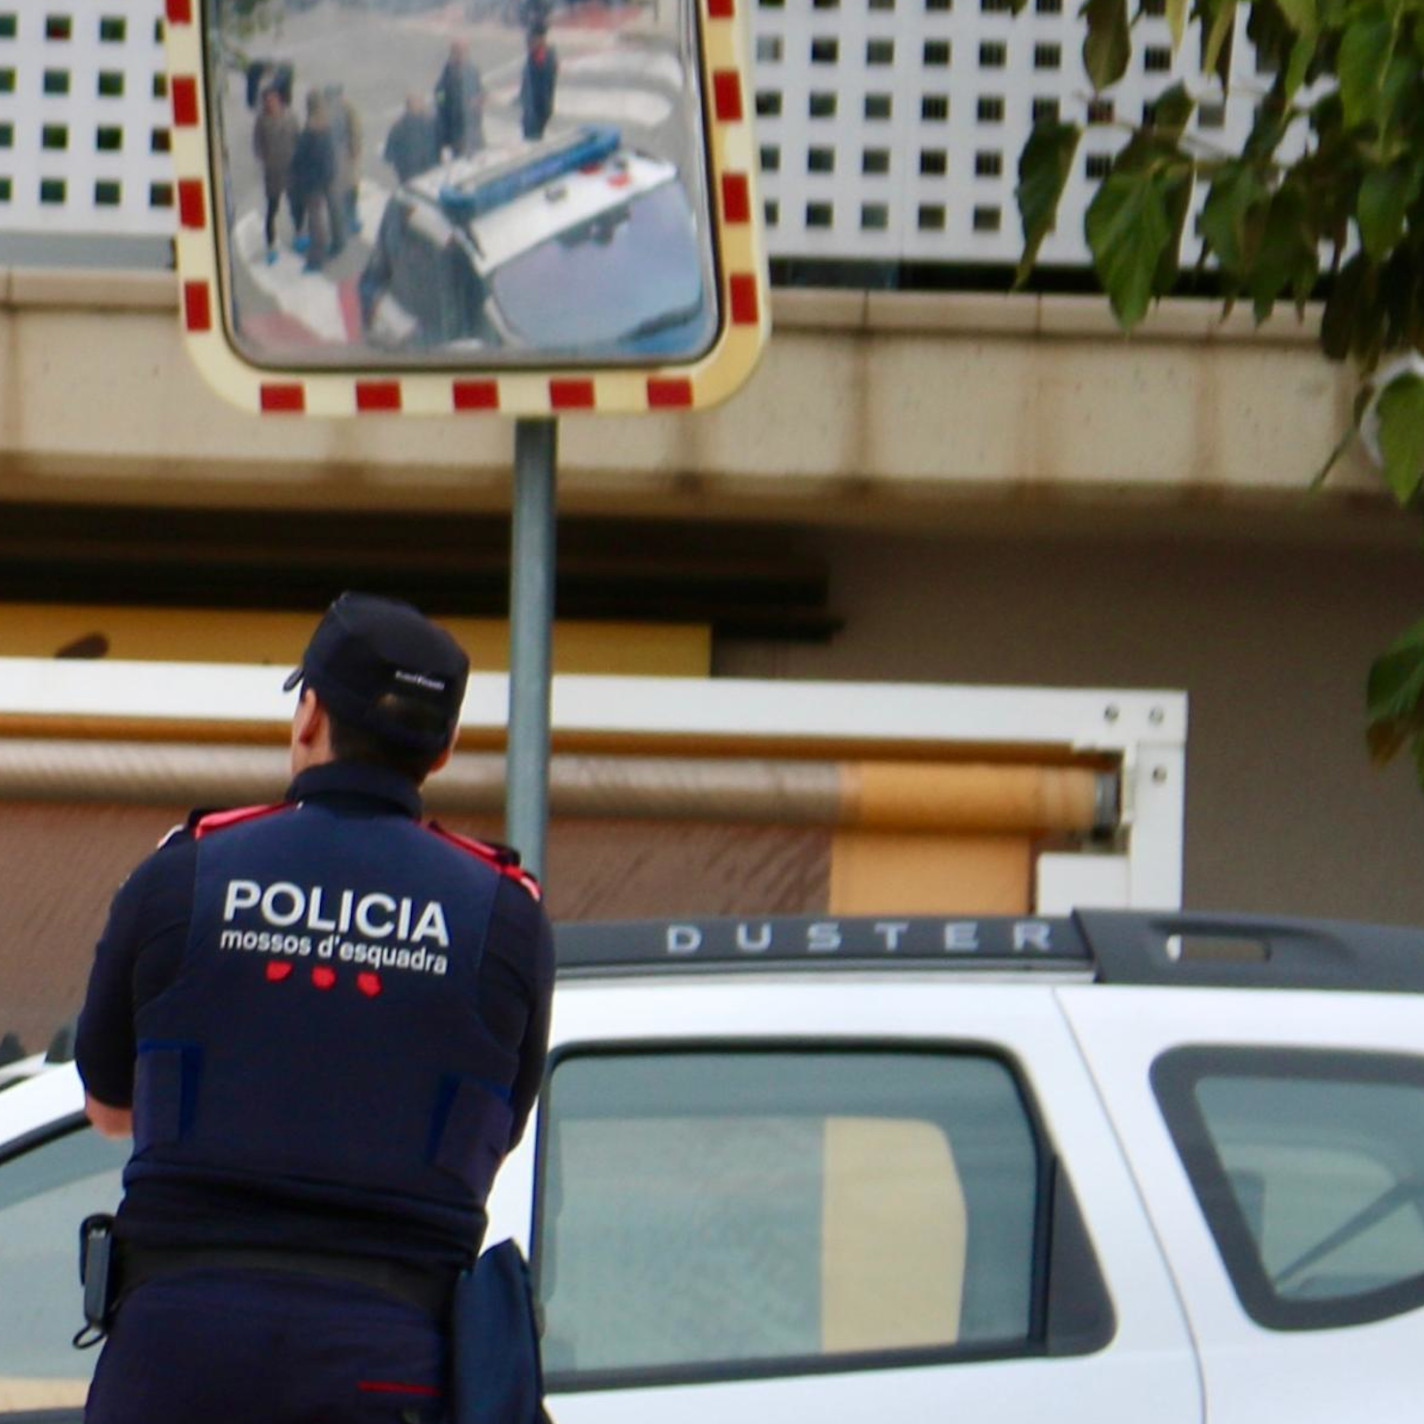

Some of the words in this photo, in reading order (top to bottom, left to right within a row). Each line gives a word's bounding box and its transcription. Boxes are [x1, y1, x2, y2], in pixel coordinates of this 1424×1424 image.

[223, 879, 450, 947] POLICIA
[220, 929, 312, 957] mossos
[317, 934, 448, 975] d'esquadra
[665, 920, 1051, 955] DUSTER
